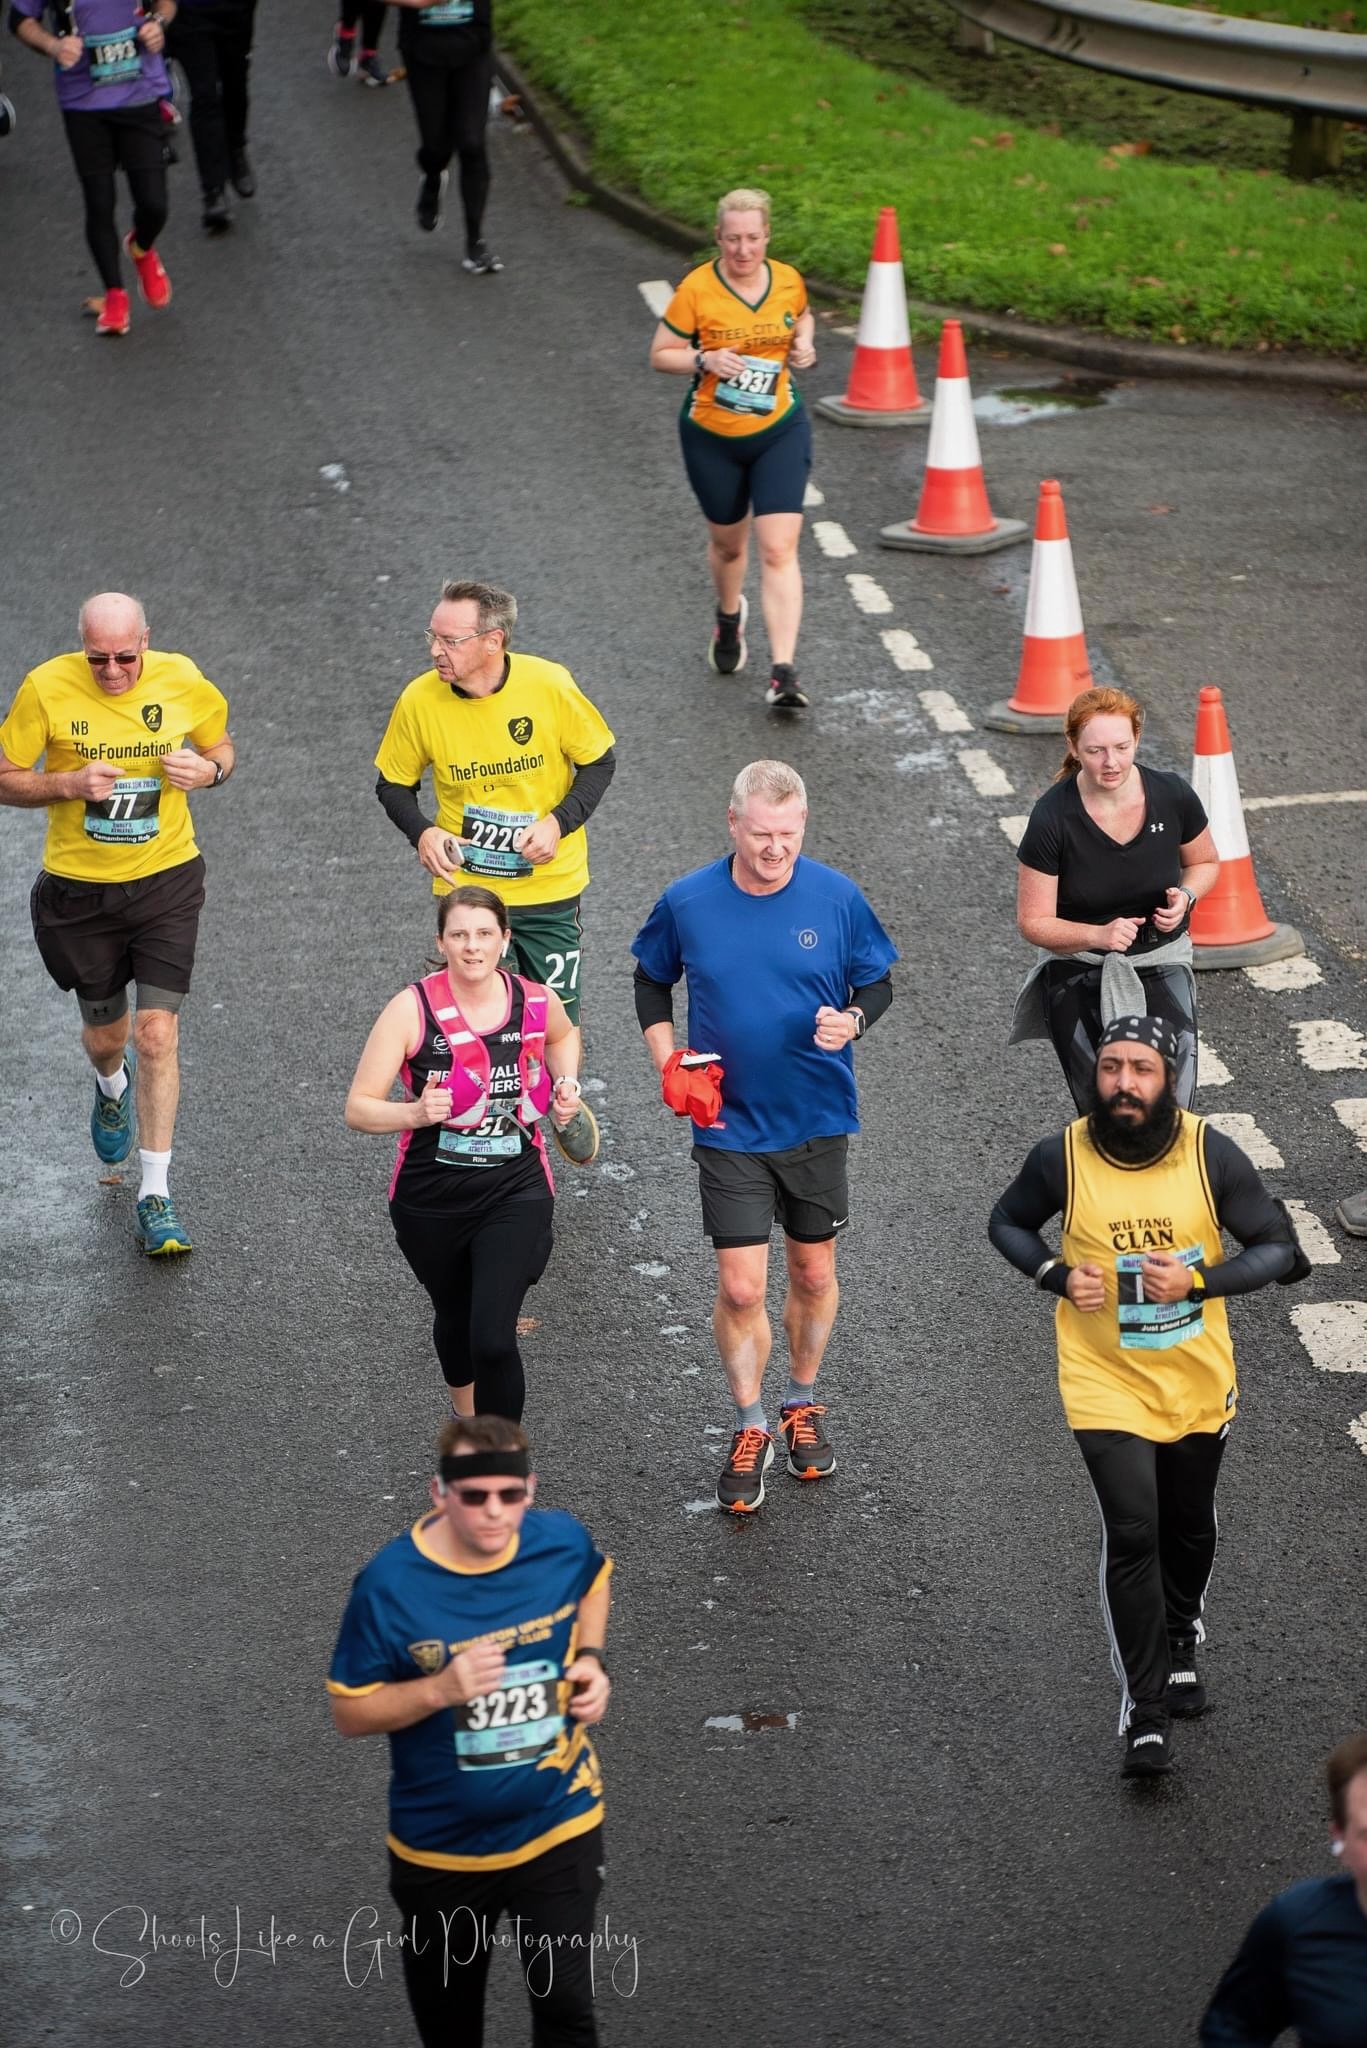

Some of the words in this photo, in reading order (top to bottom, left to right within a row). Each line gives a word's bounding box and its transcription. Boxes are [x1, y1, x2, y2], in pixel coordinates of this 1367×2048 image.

[710, 328, 749, 340] STEEL
[752, 323, 780, 335] CITY
[71, 721, 89, 736] NB
[73, 741, 172, 760] TheFoundation
[449, 753, 545, 782] TheFoundation
[545, 950, 580, 989] 27
[1112, 1229, 1175, 1252] CLAN
[1141, 1324, 1159, 1332] Just
[1168, 1671, 1197, 1685] PUMA
[466, 1683, 549, 1731] 3223
[1133, 1733, 1164, 1748] PUMA
